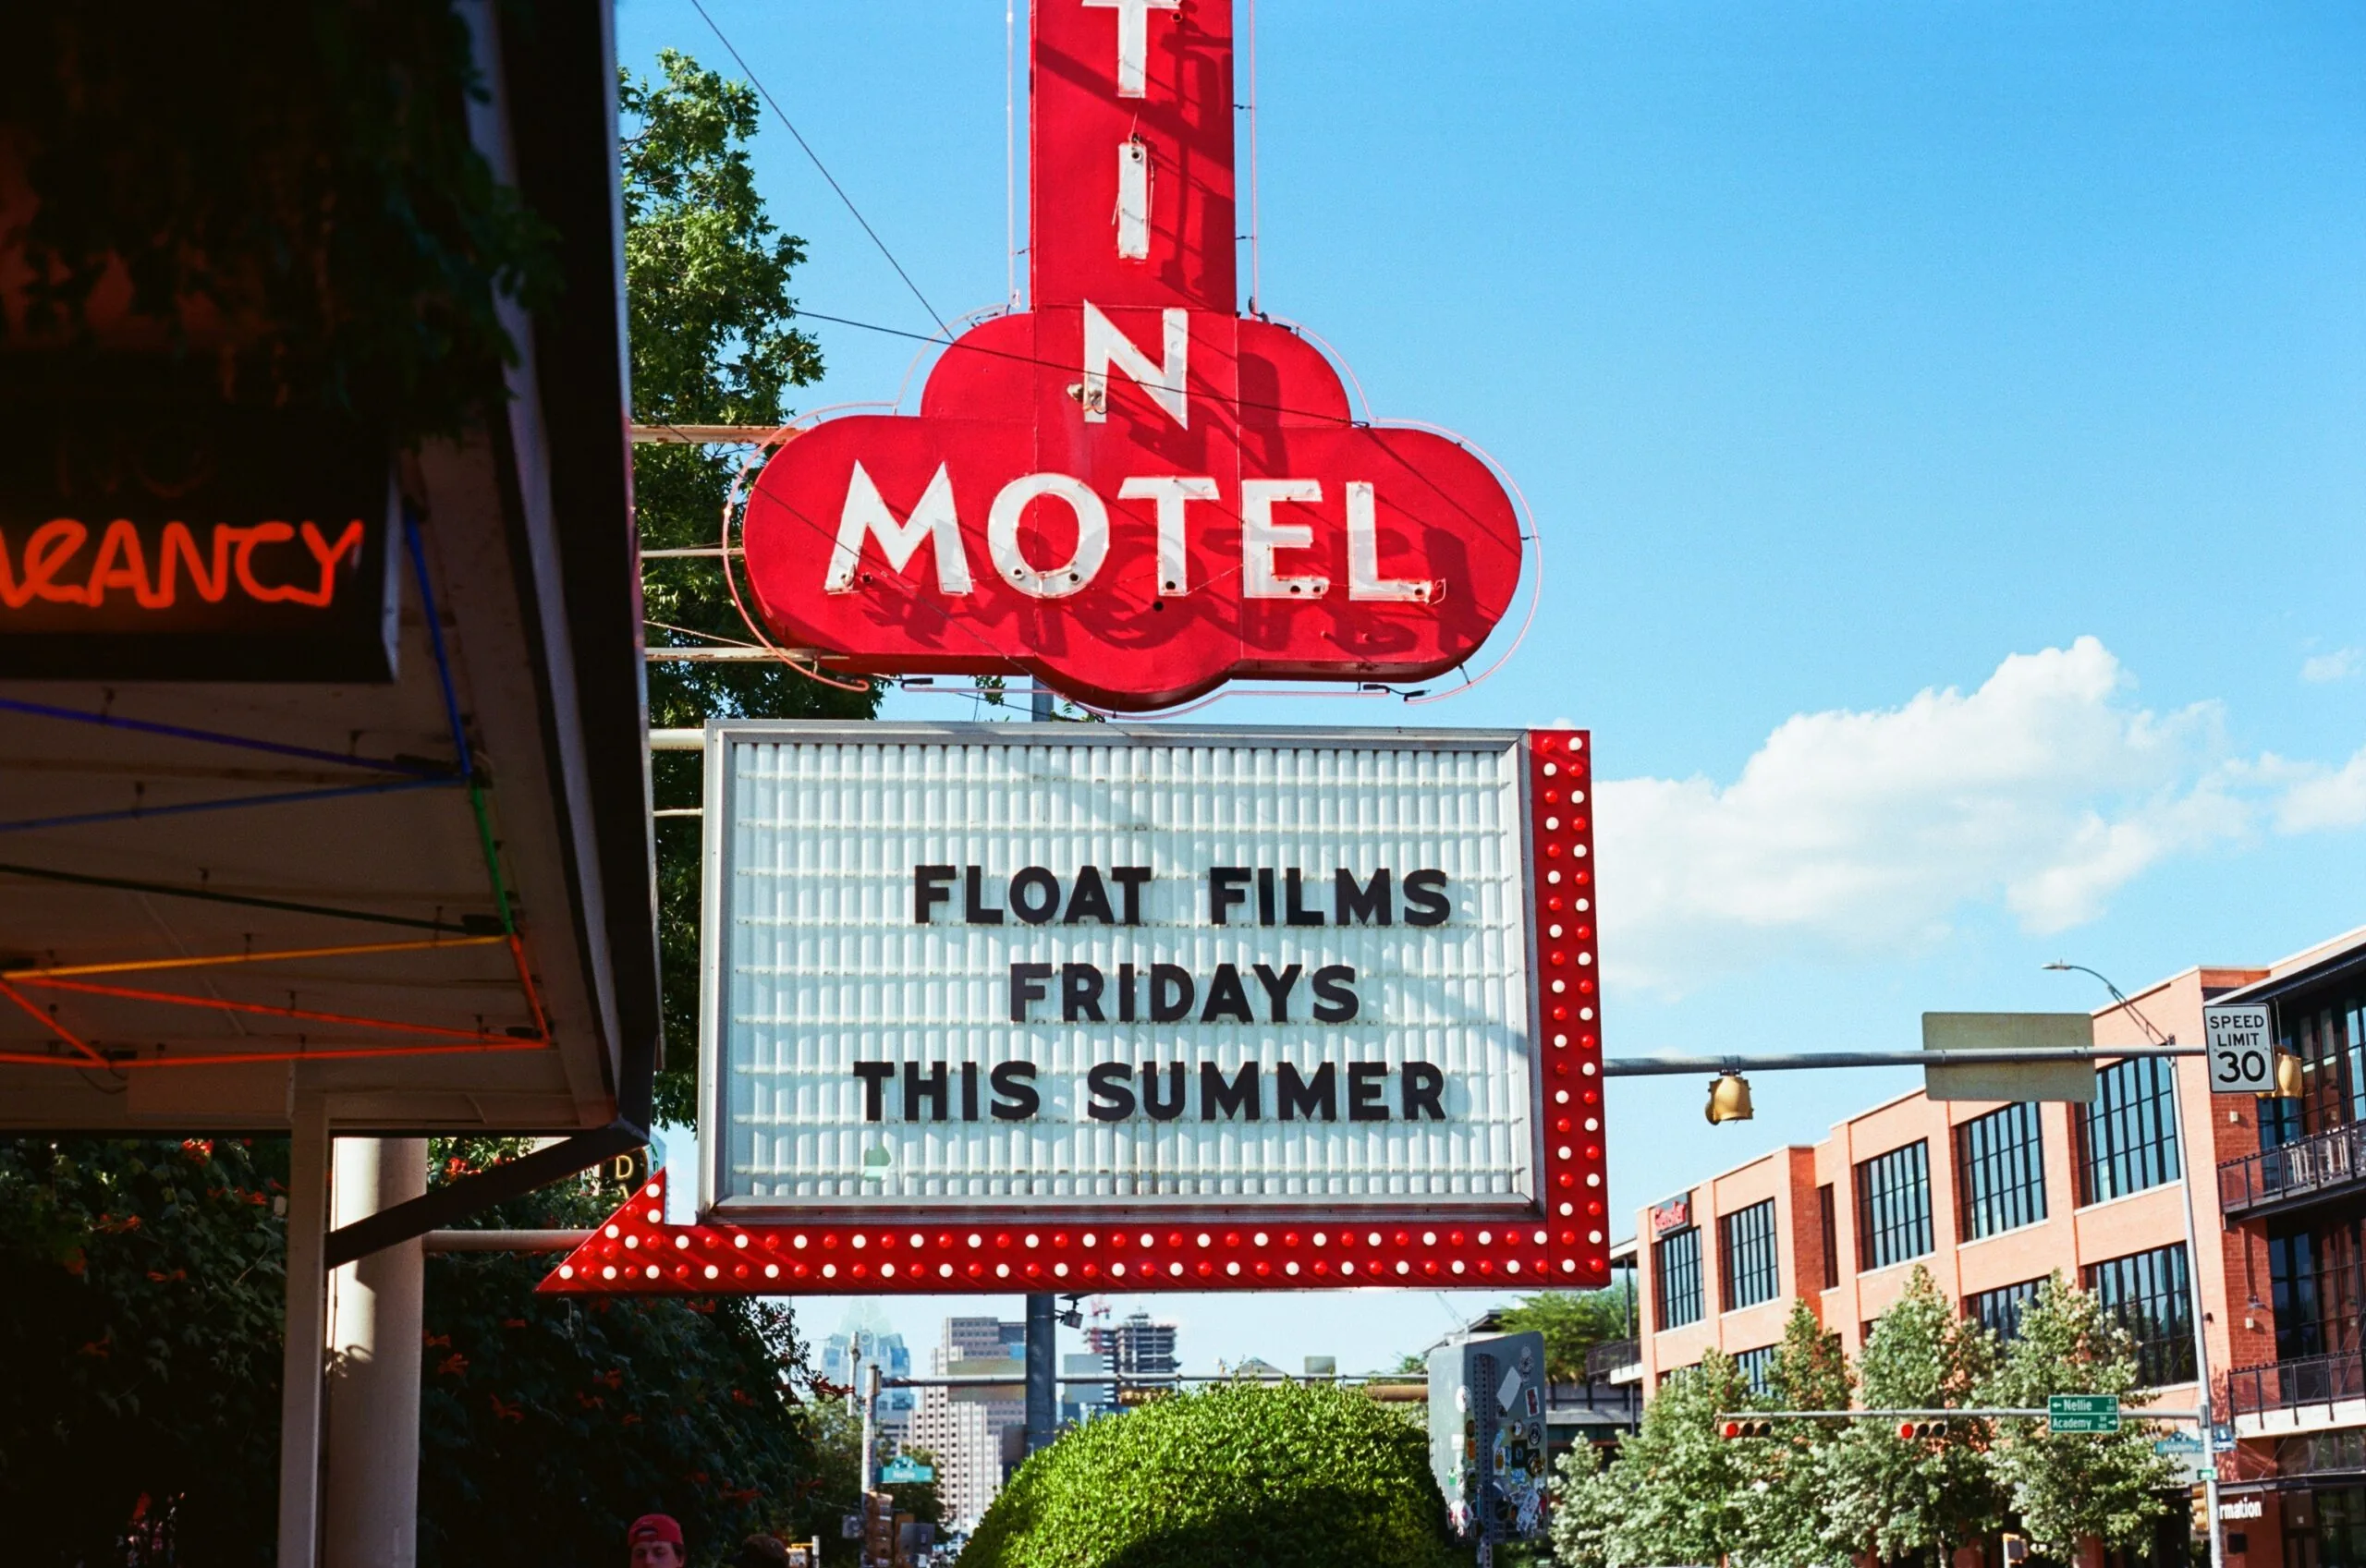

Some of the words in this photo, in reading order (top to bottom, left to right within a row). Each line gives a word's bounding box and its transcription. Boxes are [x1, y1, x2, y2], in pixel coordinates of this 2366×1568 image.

[824, 460, 1438, 602] MOTEL
[915, 865, 1152, 926] FLOAT
[1210, 867, 1451, 927] FILMS
[1010, 963, 1360, 1024] FRIDAYS
[2210, 1015, 2264, 1029] SPEED
[2217, 1033, 2260, 1047] LIMIT
[2217, 1050, 2267, 1083] 30
[853, 1061, 1041, 1122] THIS
[1087, 1061, 1447, 1122] SUMMER
[2063, 1398, 2092, 1412] Nellie
[2052, 1417, 2092, 1430] Academy
